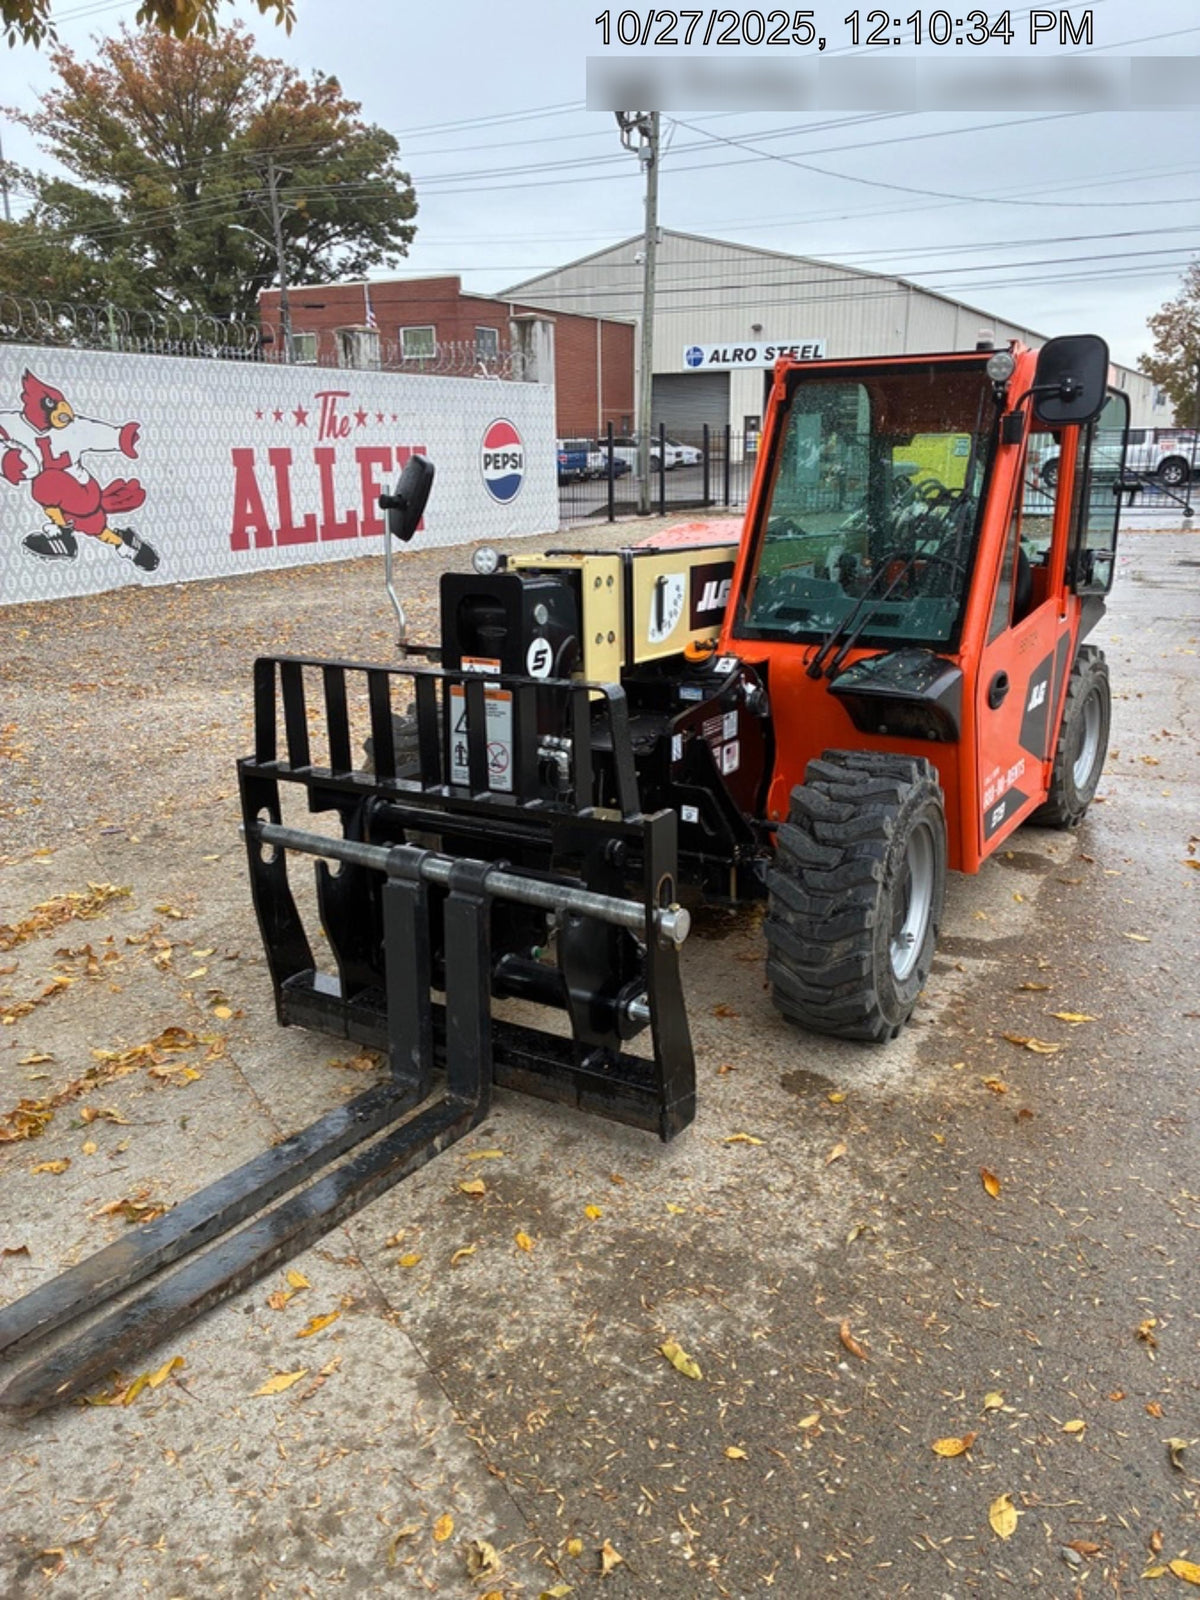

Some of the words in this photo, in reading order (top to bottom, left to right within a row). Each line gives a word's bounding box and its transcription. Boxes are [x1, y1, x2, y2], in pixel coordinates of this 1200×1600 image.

[708, 347, 757, 363] ALRO
[764, 344, 823, 361] STEEL
[314, 390, 351, 441] The
[483, 452, 523, 471] PEPSI
